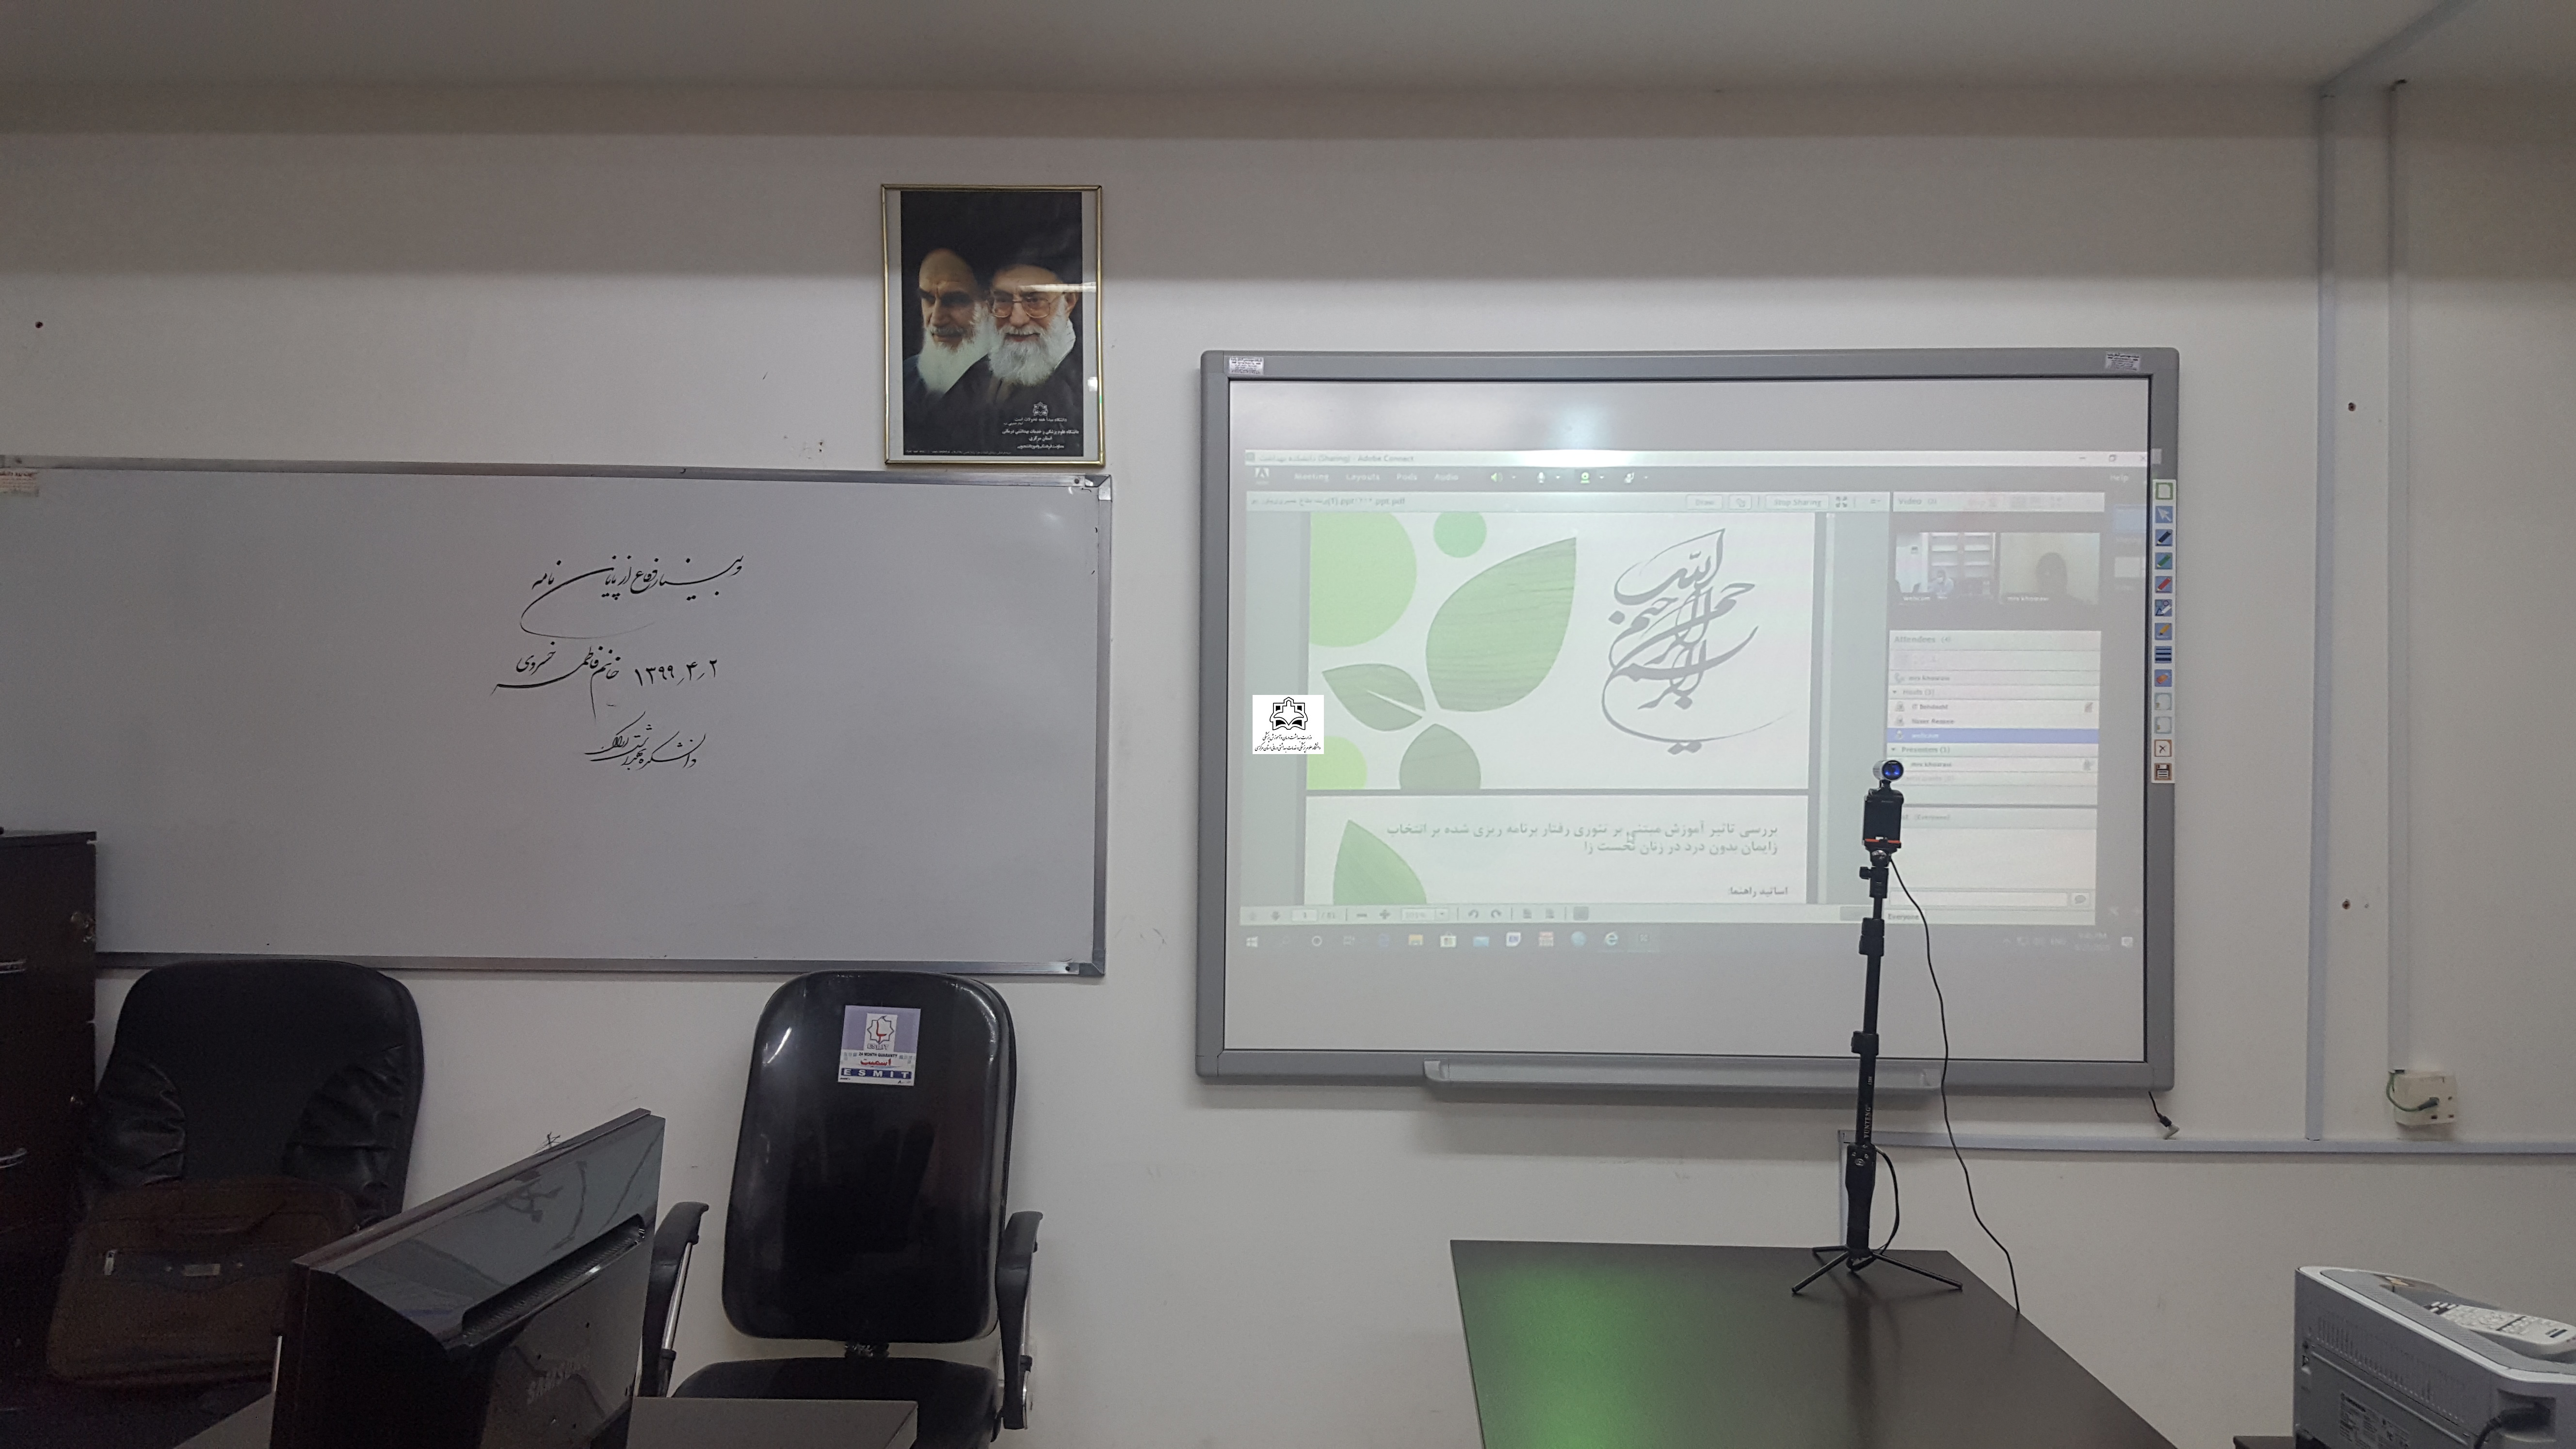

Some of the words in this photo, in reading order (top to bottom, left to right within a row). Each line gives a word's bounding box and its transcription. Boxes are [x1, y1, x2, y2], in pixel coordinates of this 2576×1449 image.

[1294, 473, 1329, 482] Meeting
[1346, 473, 1380, 482] Layouts
[1434, 472, 1459, 481] Audio
[2110, 474, 2129, 483] Help
[1774, 499, 1790, 507] Stop
[1793, 498, 1822, 508] Sharing
[1386, 823, 1427, 837] انتخاب
[1431, 827, 1441, 838] بر
[1444, 823, 1470, 834] شده
[1473, 825, 1502, 837] ریزی
[1506, 823, 1538, 837] برنامه
[1541, 822, 1570, 837] رفتار
[1612, 826, 1623, 837] بر
[1628, 823, 1661, 838] مبتنی
[1664, 820, 1705, 837] آموزش
[1739, 825, 1778, 837] بررسی
[1639, 840, 1664, 855] زنان
[1667, 843, 1680, 855] در
[1685, 843, 1705, 855] درد
[1708, 843, 1739, 855] بدون
[1740, 841, 1778, 855] زایمان
[1759, 886, 1788, 896] اساتید
[843, 1069, 909, 1079] ESMIT
